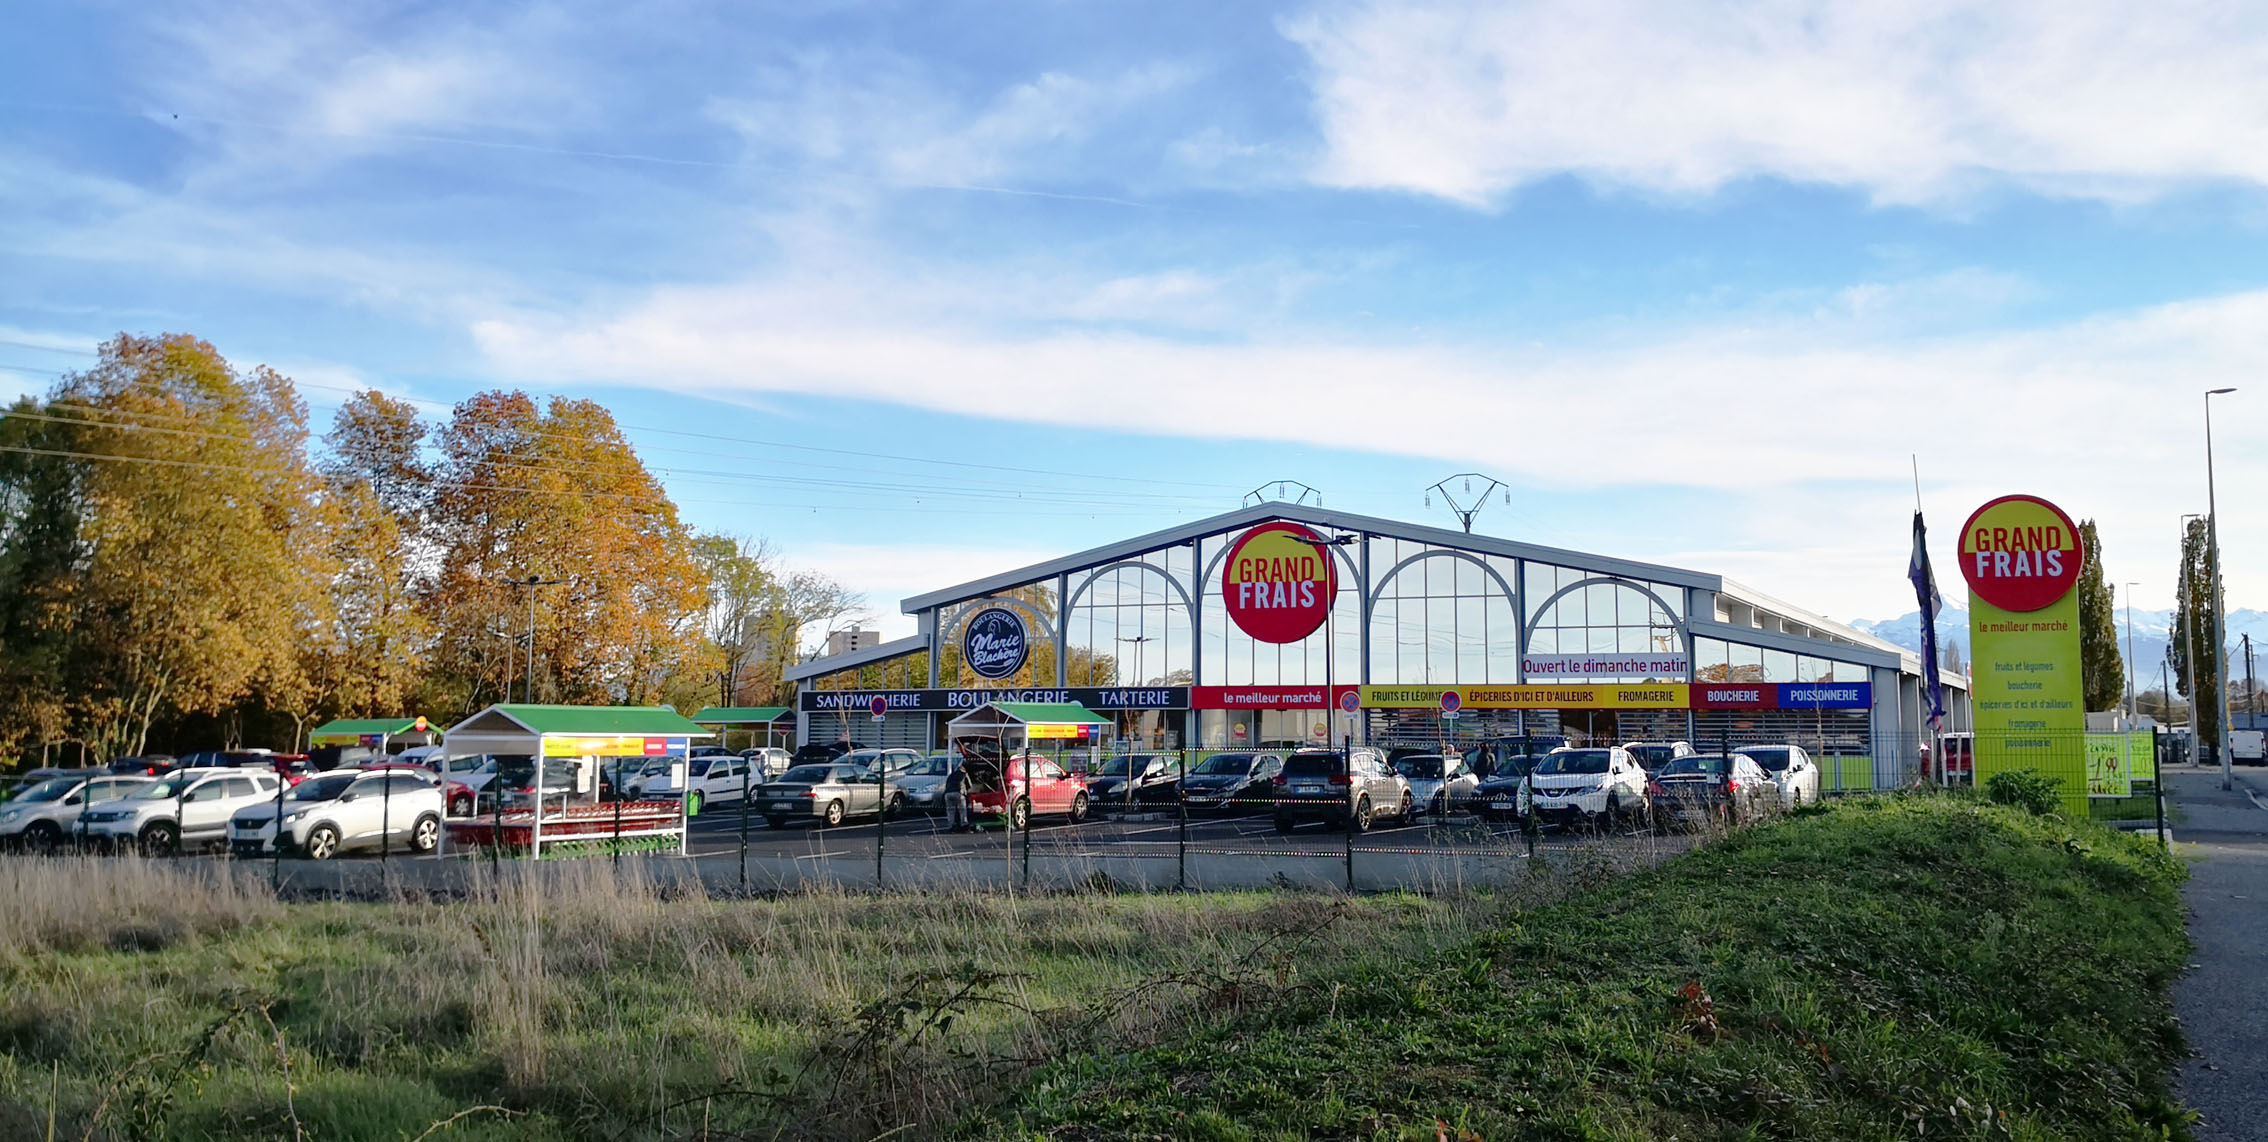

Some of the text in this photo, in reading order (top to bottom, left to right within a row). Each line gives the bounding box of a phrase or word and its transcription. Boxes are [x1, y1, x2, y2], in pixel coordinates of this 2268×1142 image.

[1975, 526, 2061, 552] GRAND
[1239, 556, 1315, 582] GRAND
[1976, 549, 2063, 578] FRAIS
[1239, 580, 1315, 609] FRAIS
[1979, 619, 2068, 632] le meilleur marché
[971, 633, 1020, 652] Marie
[1522, 658, 1688, 673] Ouvert le dimanche matin
[1098, 691, 1170, 706] TARTERIE
[1223, 691, 1322, 704] le meilleur marché
[1371, 691, 1400, 702] FRUITS
[1401, 691, 1410, 702] ET
[1469, 689, 1594, 702] ÉPICERIES D'ICI ET D'AILLEURS
[1618, 690, 1675, 702] FROMAGERIE
[1707, 690, 1760, 702] BOUCHERIE
[1790, 689, 1859, 701] POISSONNERIE
